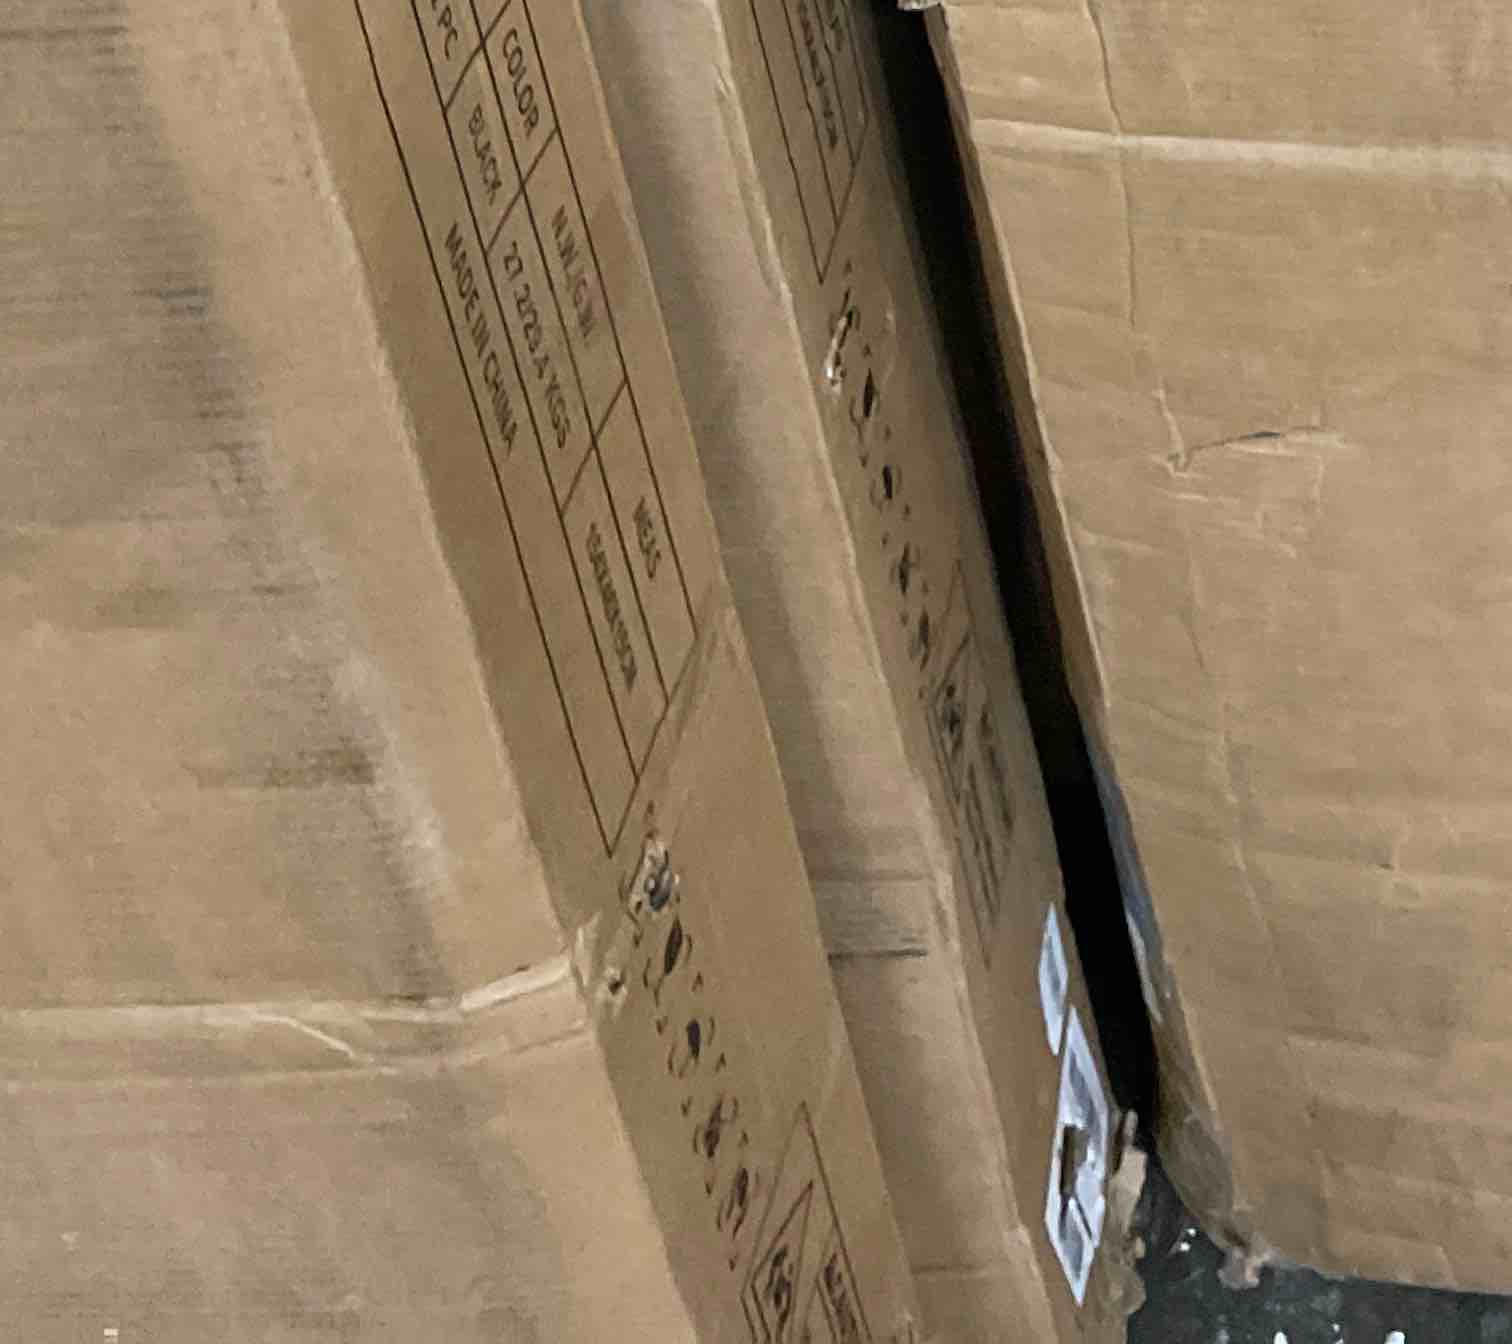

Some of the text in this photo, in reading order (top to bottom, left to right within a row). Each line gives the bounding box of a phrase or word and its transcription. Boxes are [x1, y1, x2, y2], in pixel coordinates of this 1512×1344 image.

[498, 21, 541, 146] COLOR
[464, 100, 503, 211] BLACK
[443, 218, 520, 461] MADE IN CHINA
